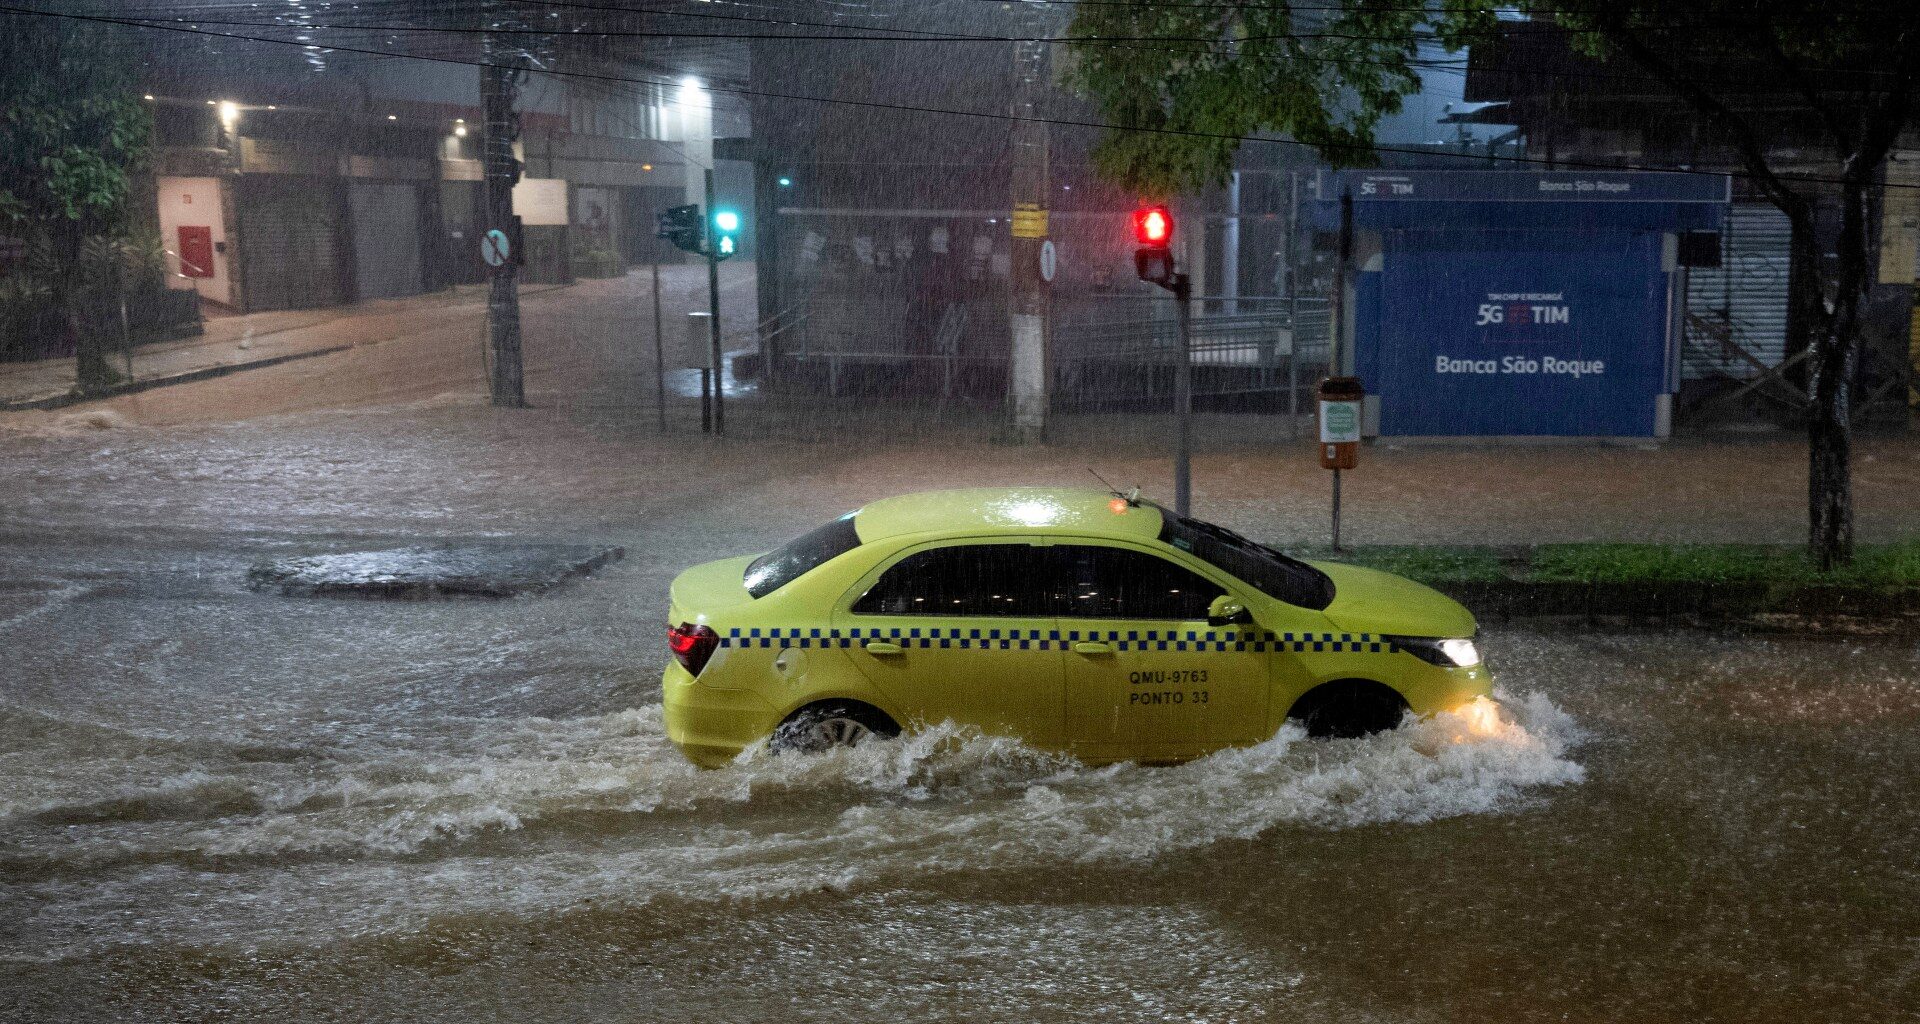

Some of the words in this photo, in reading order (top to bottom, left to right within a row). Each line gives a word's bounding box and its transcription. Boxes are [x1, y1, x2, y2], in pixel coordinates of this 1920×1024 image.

[1360, 182, 1376, 195] 5G
[1391, 183, 1414, 194] TIM
[1539, 181, 1573, 191] Banca
[1575, 181, 1595, 191] São
[1596, 181, 1630, 193] Roque
[1477, 304, 1504, 325] 5G
[1531, 306, 1569, 324] TIM
[1436, 355, 1498, 374] Banca
[1501, 356, 1539, 374] São
[1542, 356, 1604, 379] Roque
[1129, 670, 1208, 684] QMU-9763
[1130, 691, 1184, 705] PONTO
[1192, 691, 1209, 704] 33
